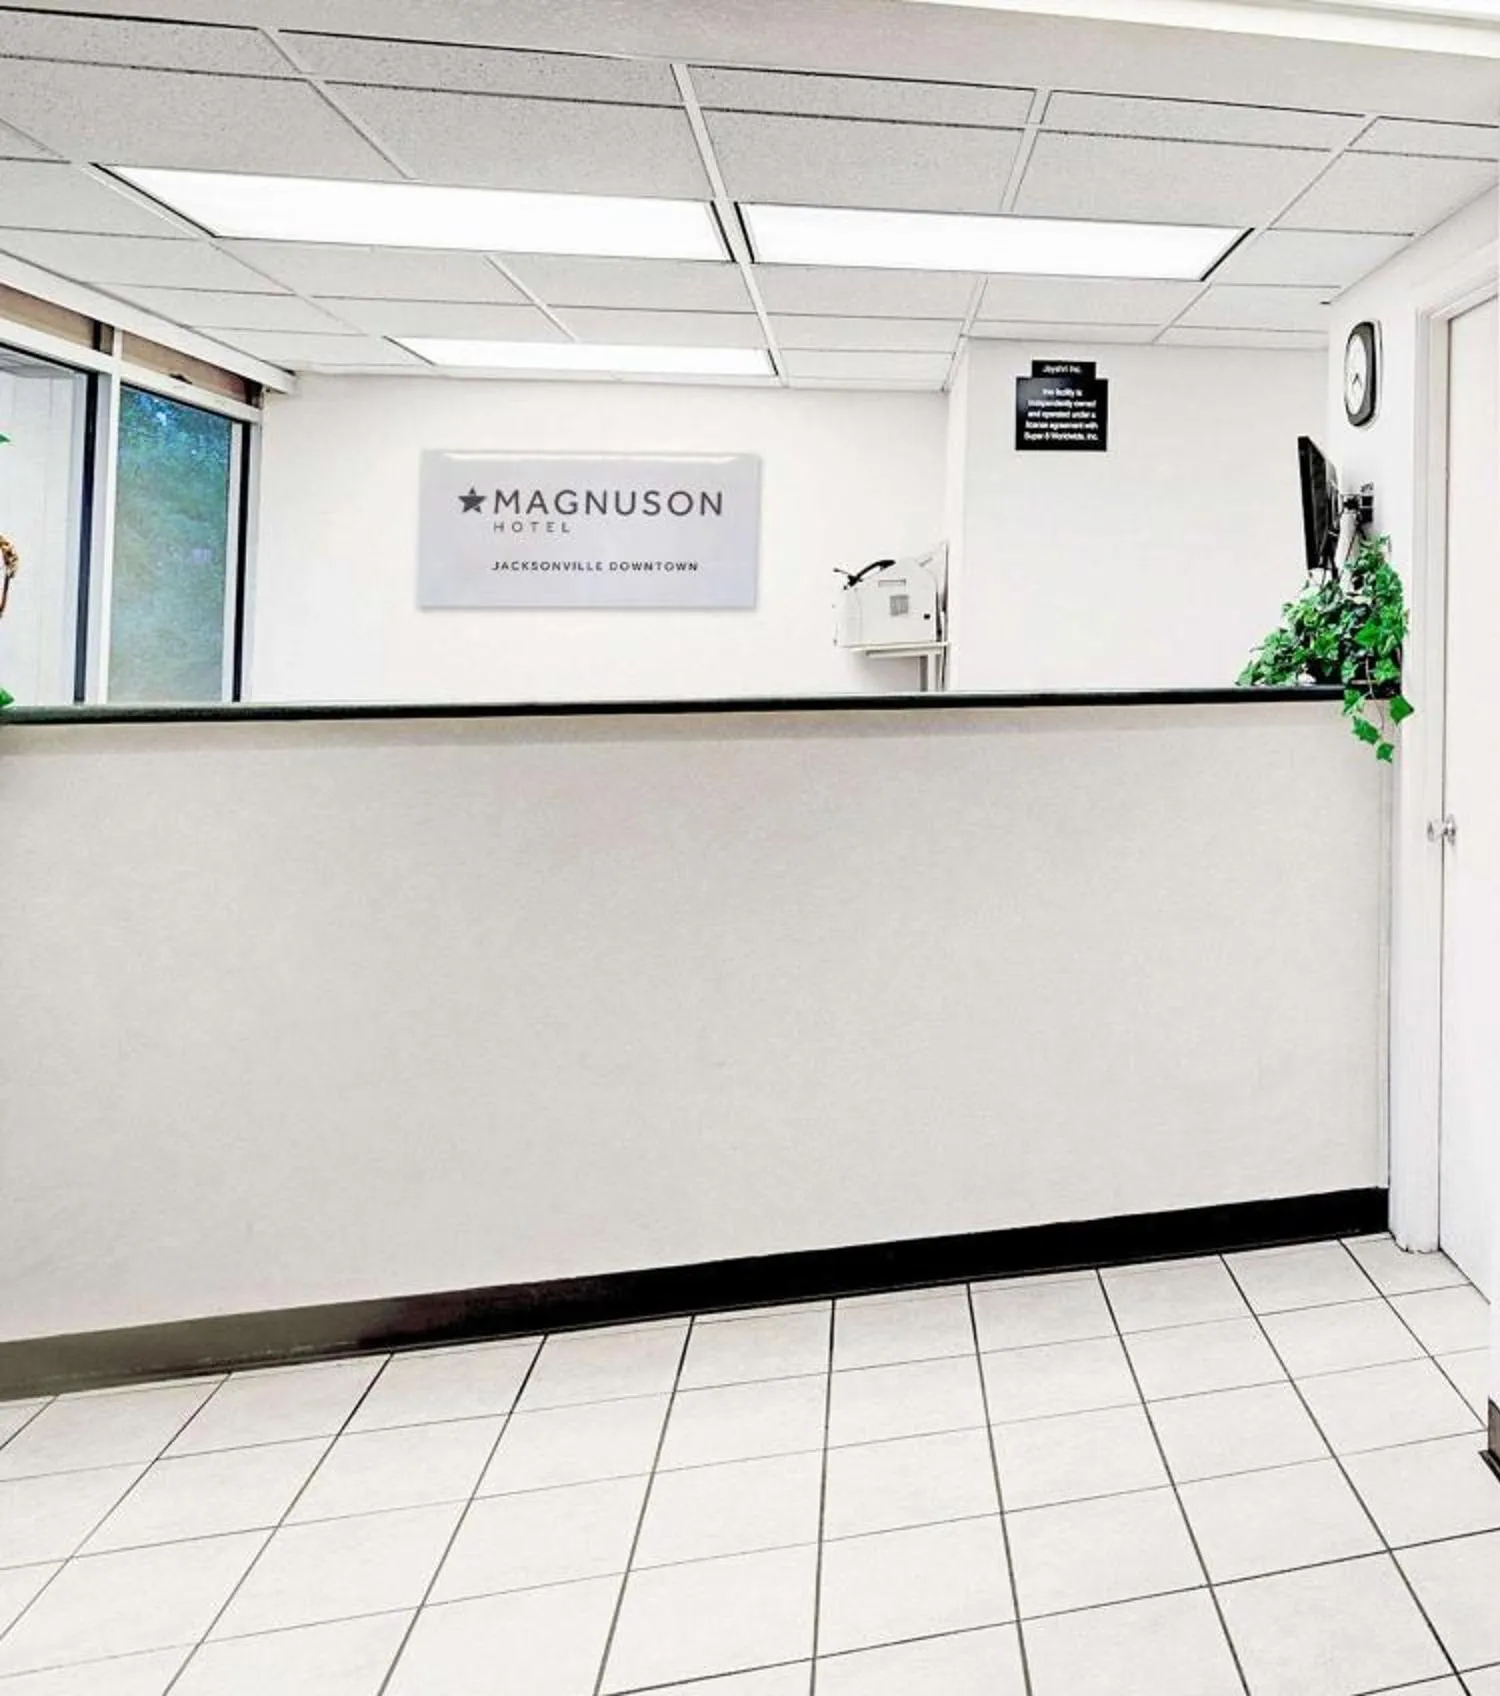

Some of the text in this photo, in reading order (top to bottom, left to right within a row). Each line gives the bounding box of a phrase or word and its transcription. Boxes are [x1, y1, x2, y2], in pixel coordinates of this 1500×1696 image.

[493, 488, 724, 517] MAGNUSON
[493, 521, 571, 534] HOTEL
[491, 561, 699, 572] JACKSONVILLE DOWNTOWN
